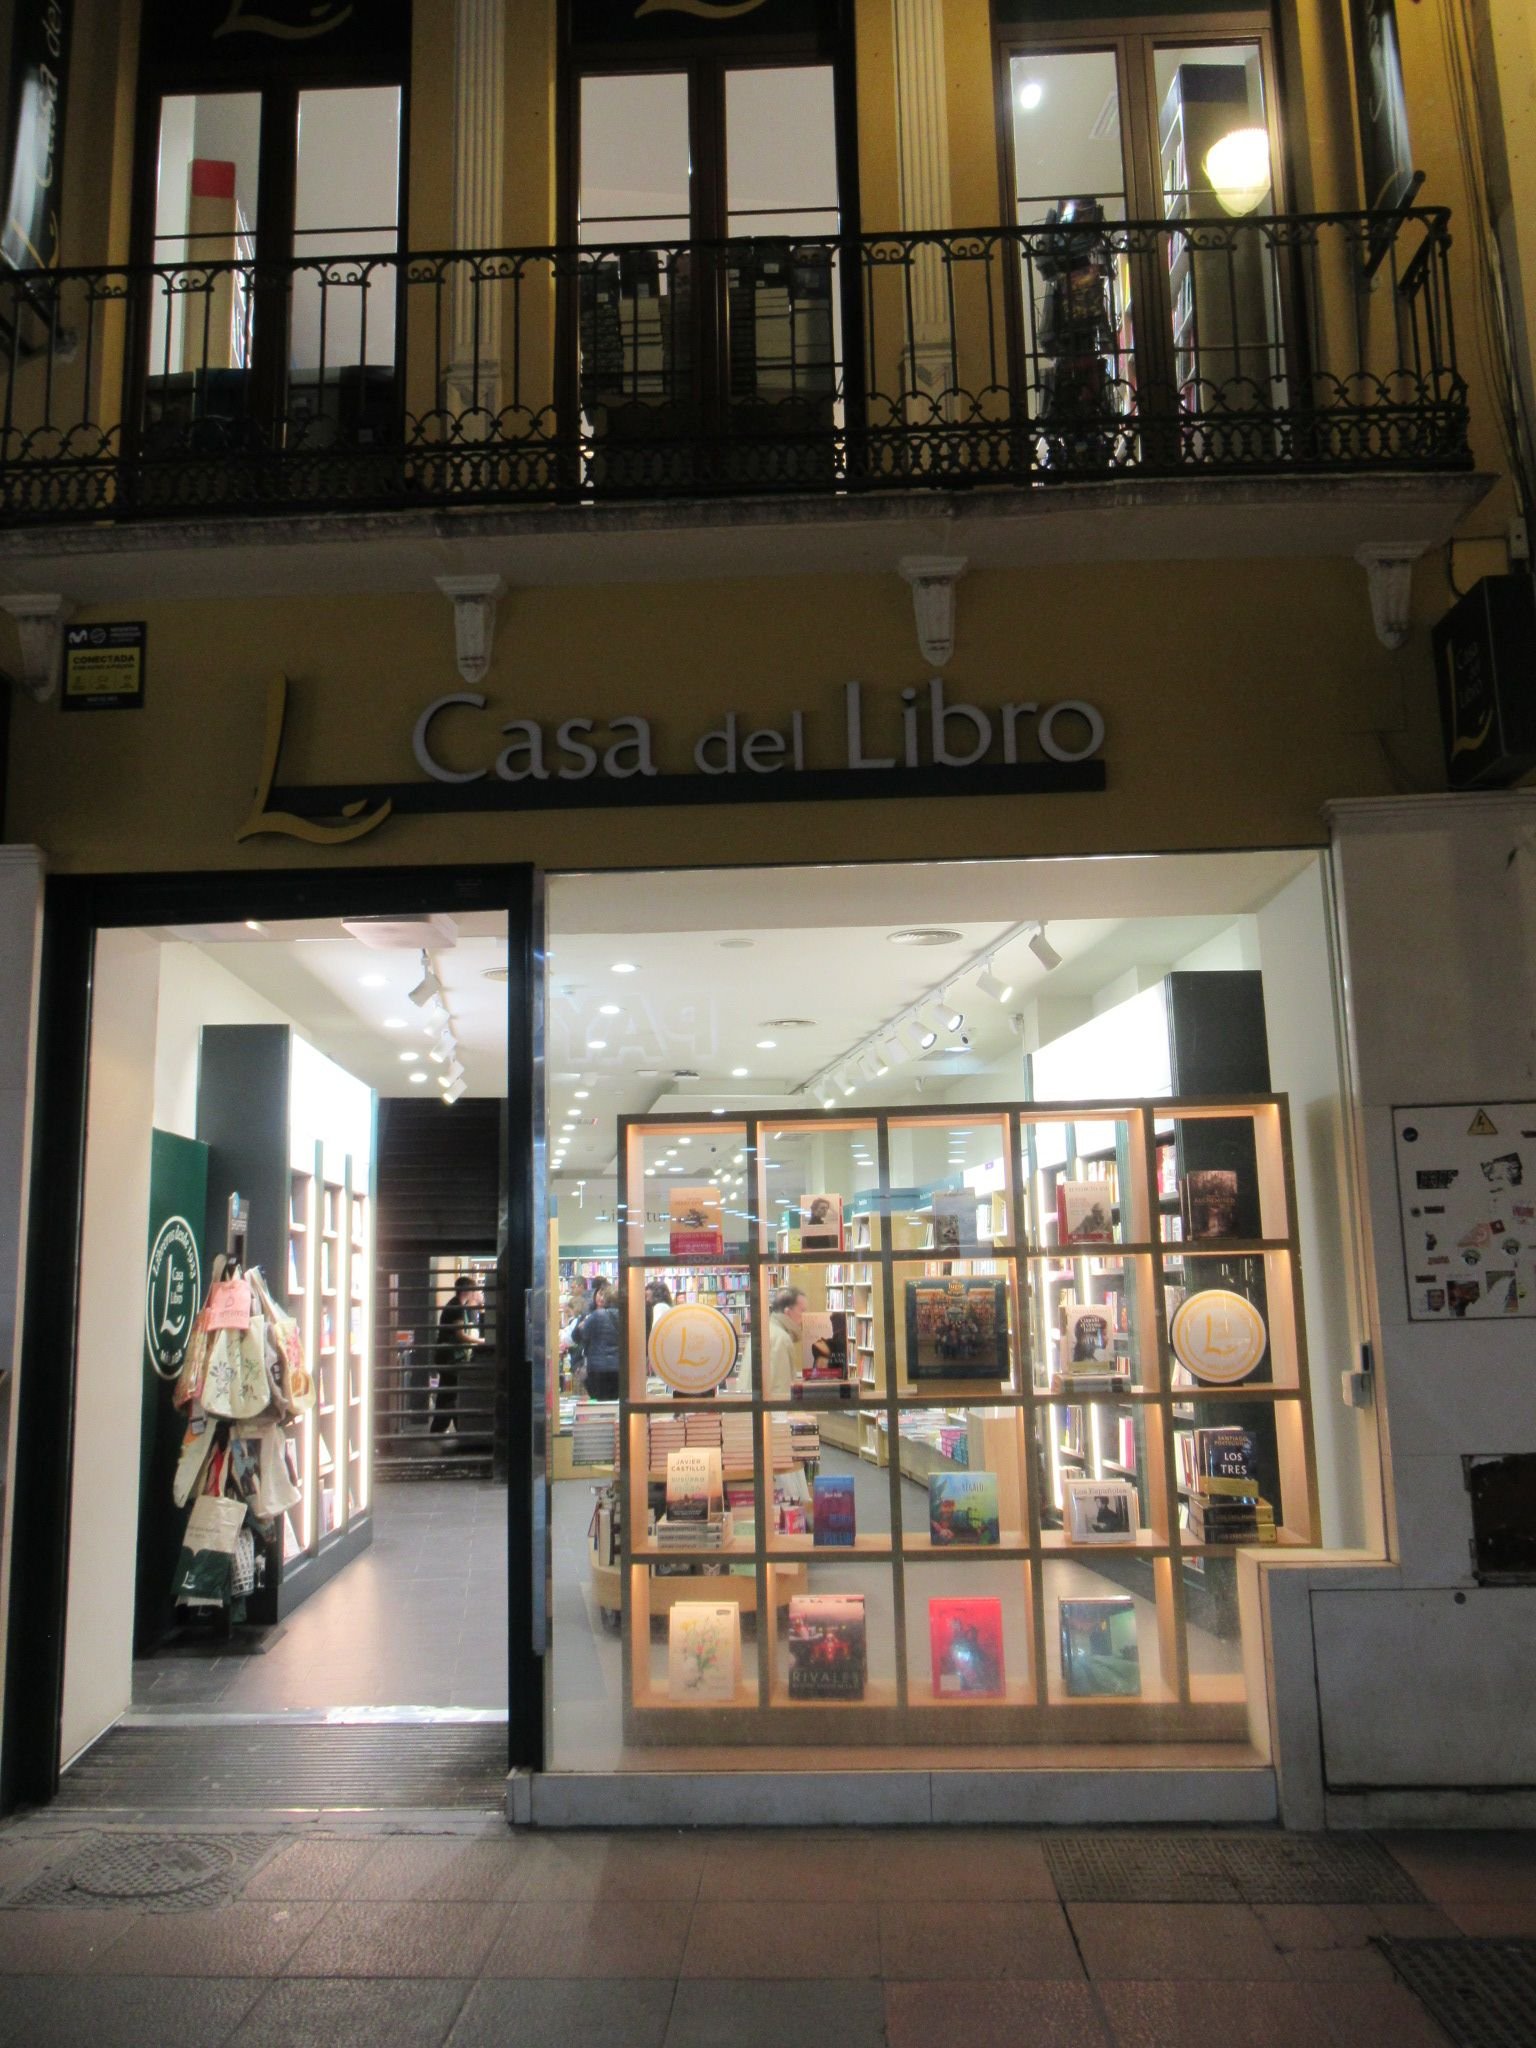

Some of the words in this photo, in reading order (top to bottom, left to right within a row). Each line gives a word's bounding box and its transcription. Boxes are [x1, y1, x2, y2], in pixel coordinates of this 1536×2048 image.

[412, 691, 658, 784] Casa
[693, 709, 804, 774] del
[846, 677, 1105, 769] Libro
[1224, 1452, 1243, 1461] LOS
[1220, 1464, 1248, 1475] TRES
[792, 1671, 859, 1683] RIVALES
